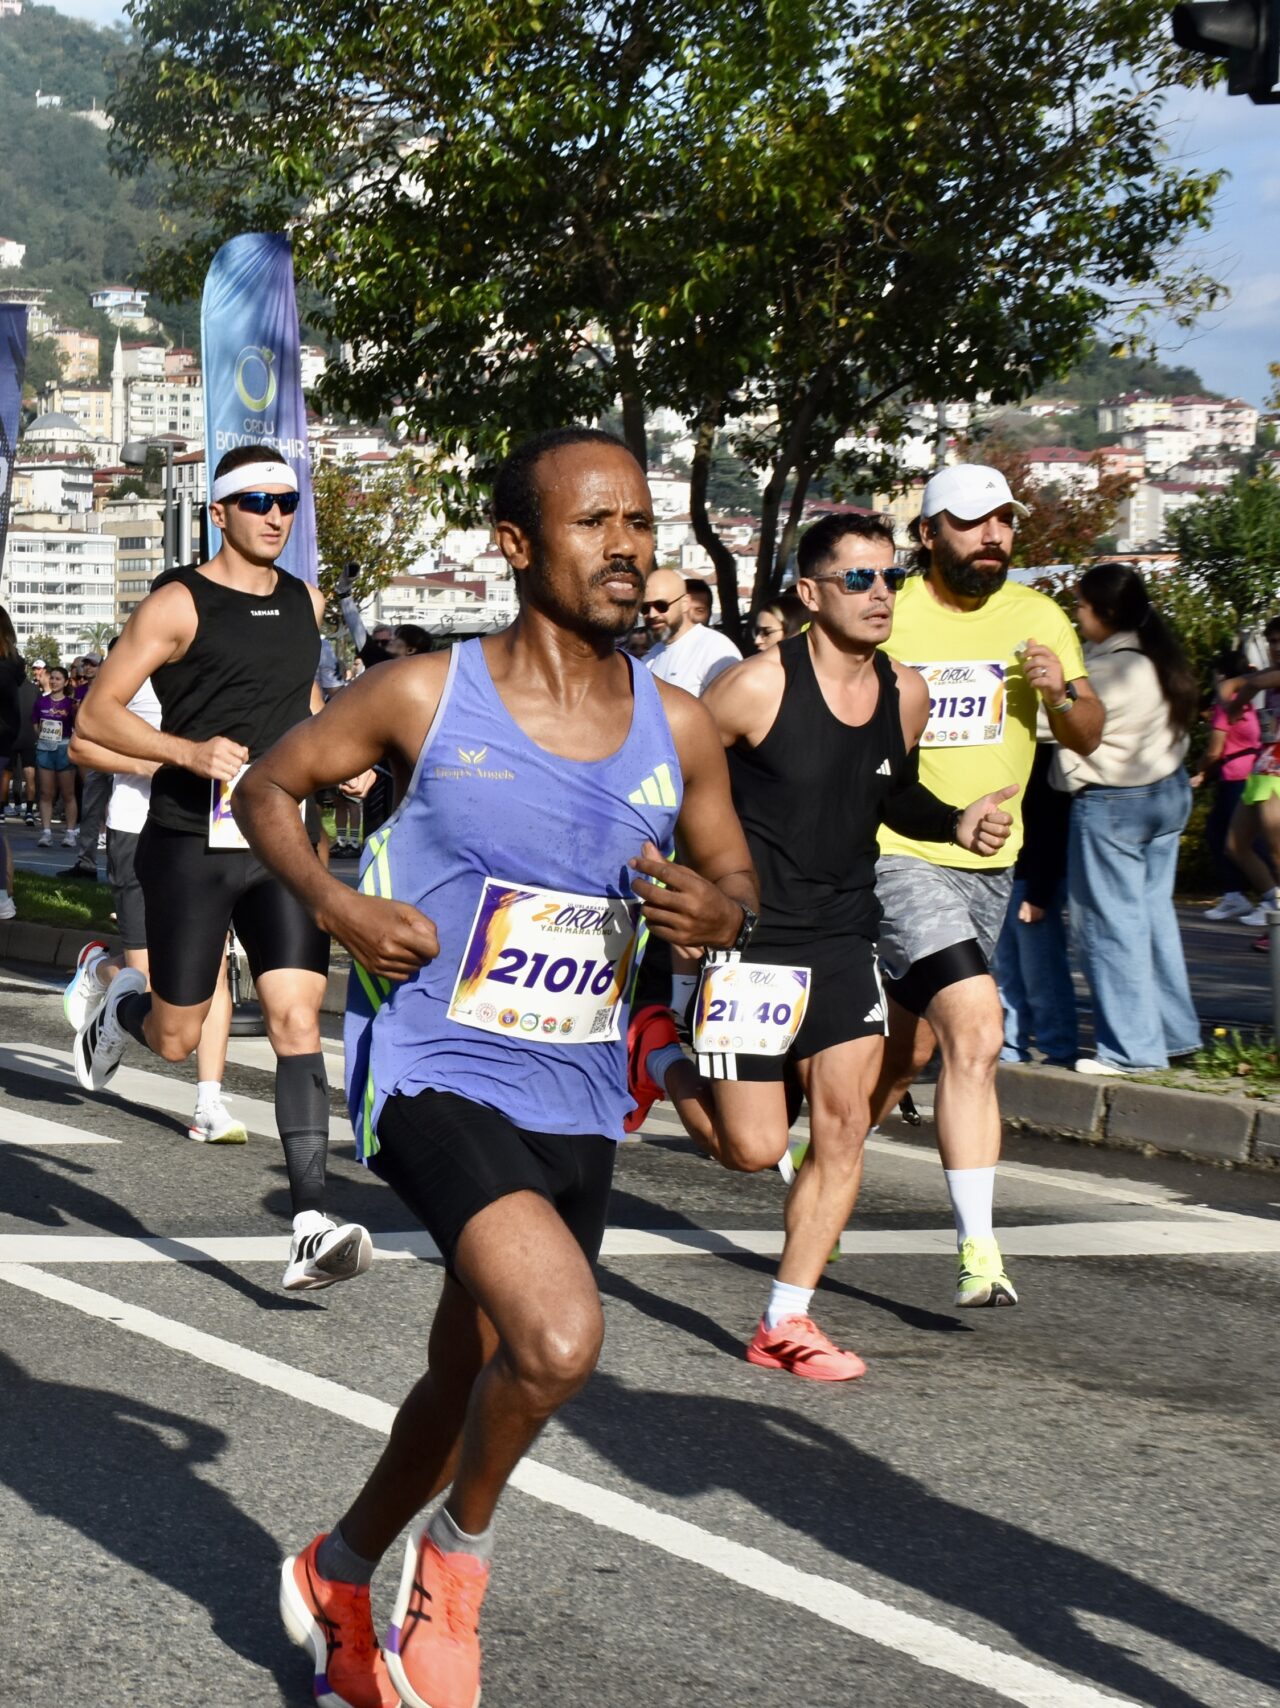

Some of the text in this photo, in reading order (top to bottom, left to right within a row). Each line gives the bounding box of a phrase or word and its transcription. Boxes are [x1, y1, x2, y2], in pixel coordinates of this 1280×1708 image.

[243, 418, 275, 435] ORDU
[540, 924, 563, 933] YARI
[554, 906, 615, 932] ORDU
[485, 947, 618, 997] 21016
[706, 999, 792, 1026] 2140
